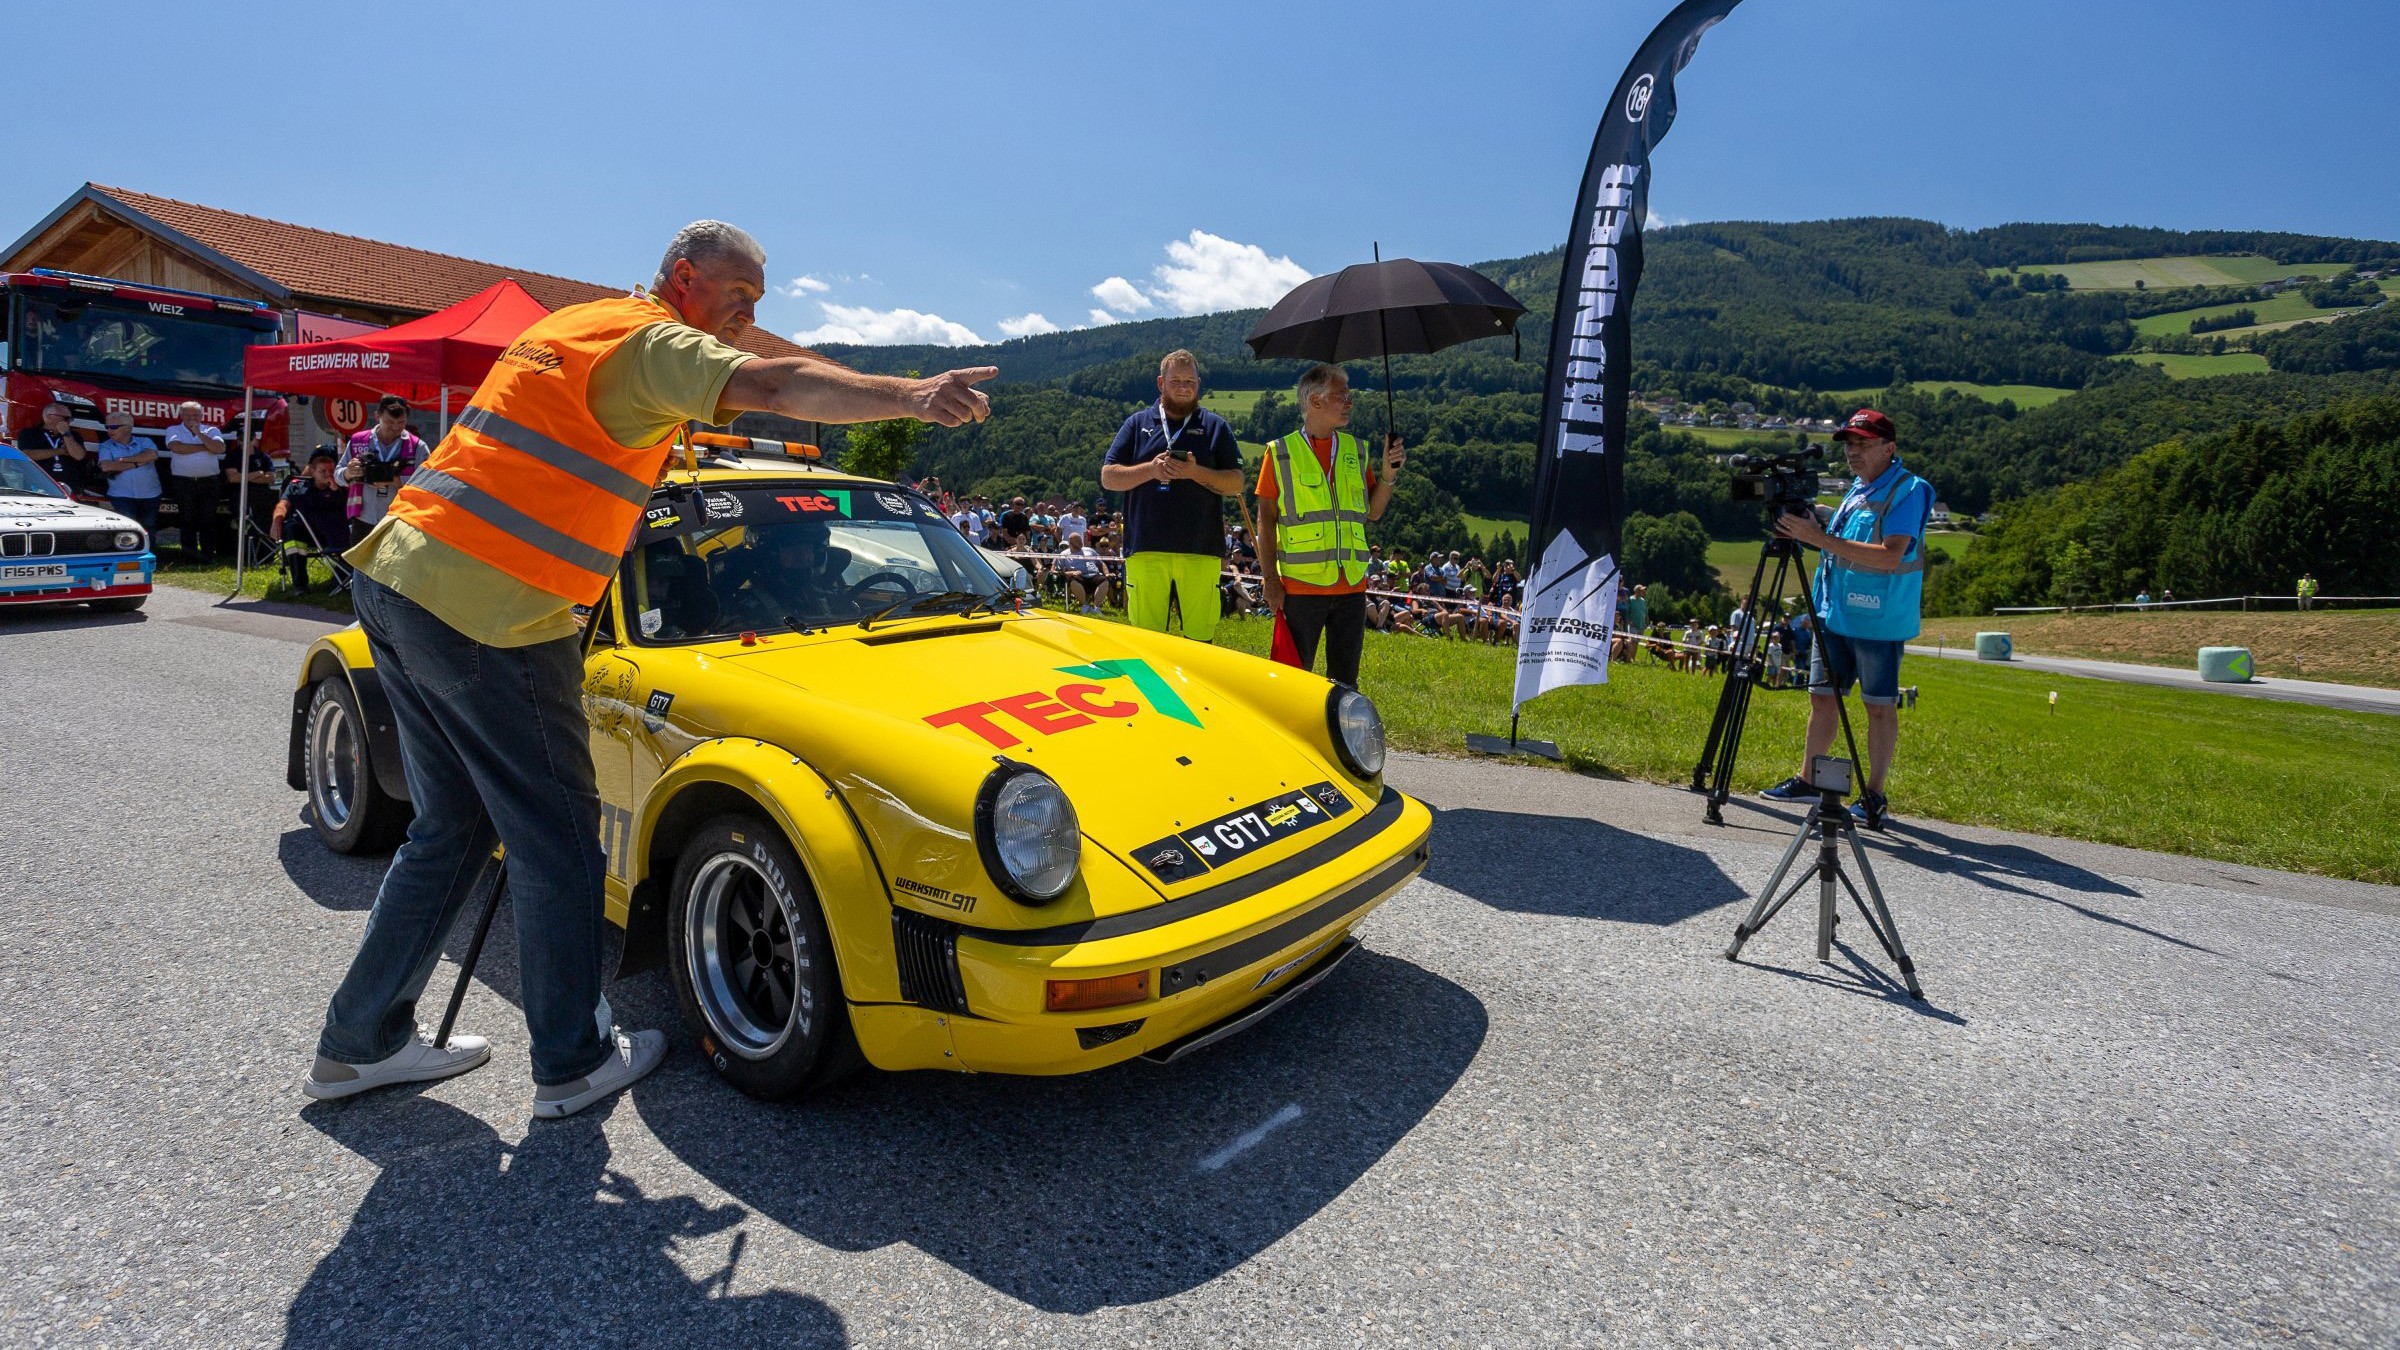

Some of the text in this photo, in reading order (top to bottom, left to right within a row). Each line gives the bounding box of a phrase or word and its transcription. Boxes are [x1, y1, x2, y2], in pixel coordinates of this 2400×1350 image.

[148, 302, 184, 316] WEIZ
[1556, 163, 1642, 459] THUNDER
[289, 353, 390, 371] FEUERWEHR WEIZ
[106, 398, 225, 422] FEUERWHR
[337, 399, 357, 424] 30
[646, 507, 671, 519] GT7
[775, 489, 852, 519] TEC7
[1529, 625, 1608, 643] OF NATURE
[1560, 617, 1609, 635] FORCE
[650, 694, 670, 710] GT7
[921, 658, 1205, 750] TEC7
[1213, 812, 1271, 849] GT7
[753, 843, 811, 967] PIRELLI
[895, 876, 977, 913] WERKSTATT 911
